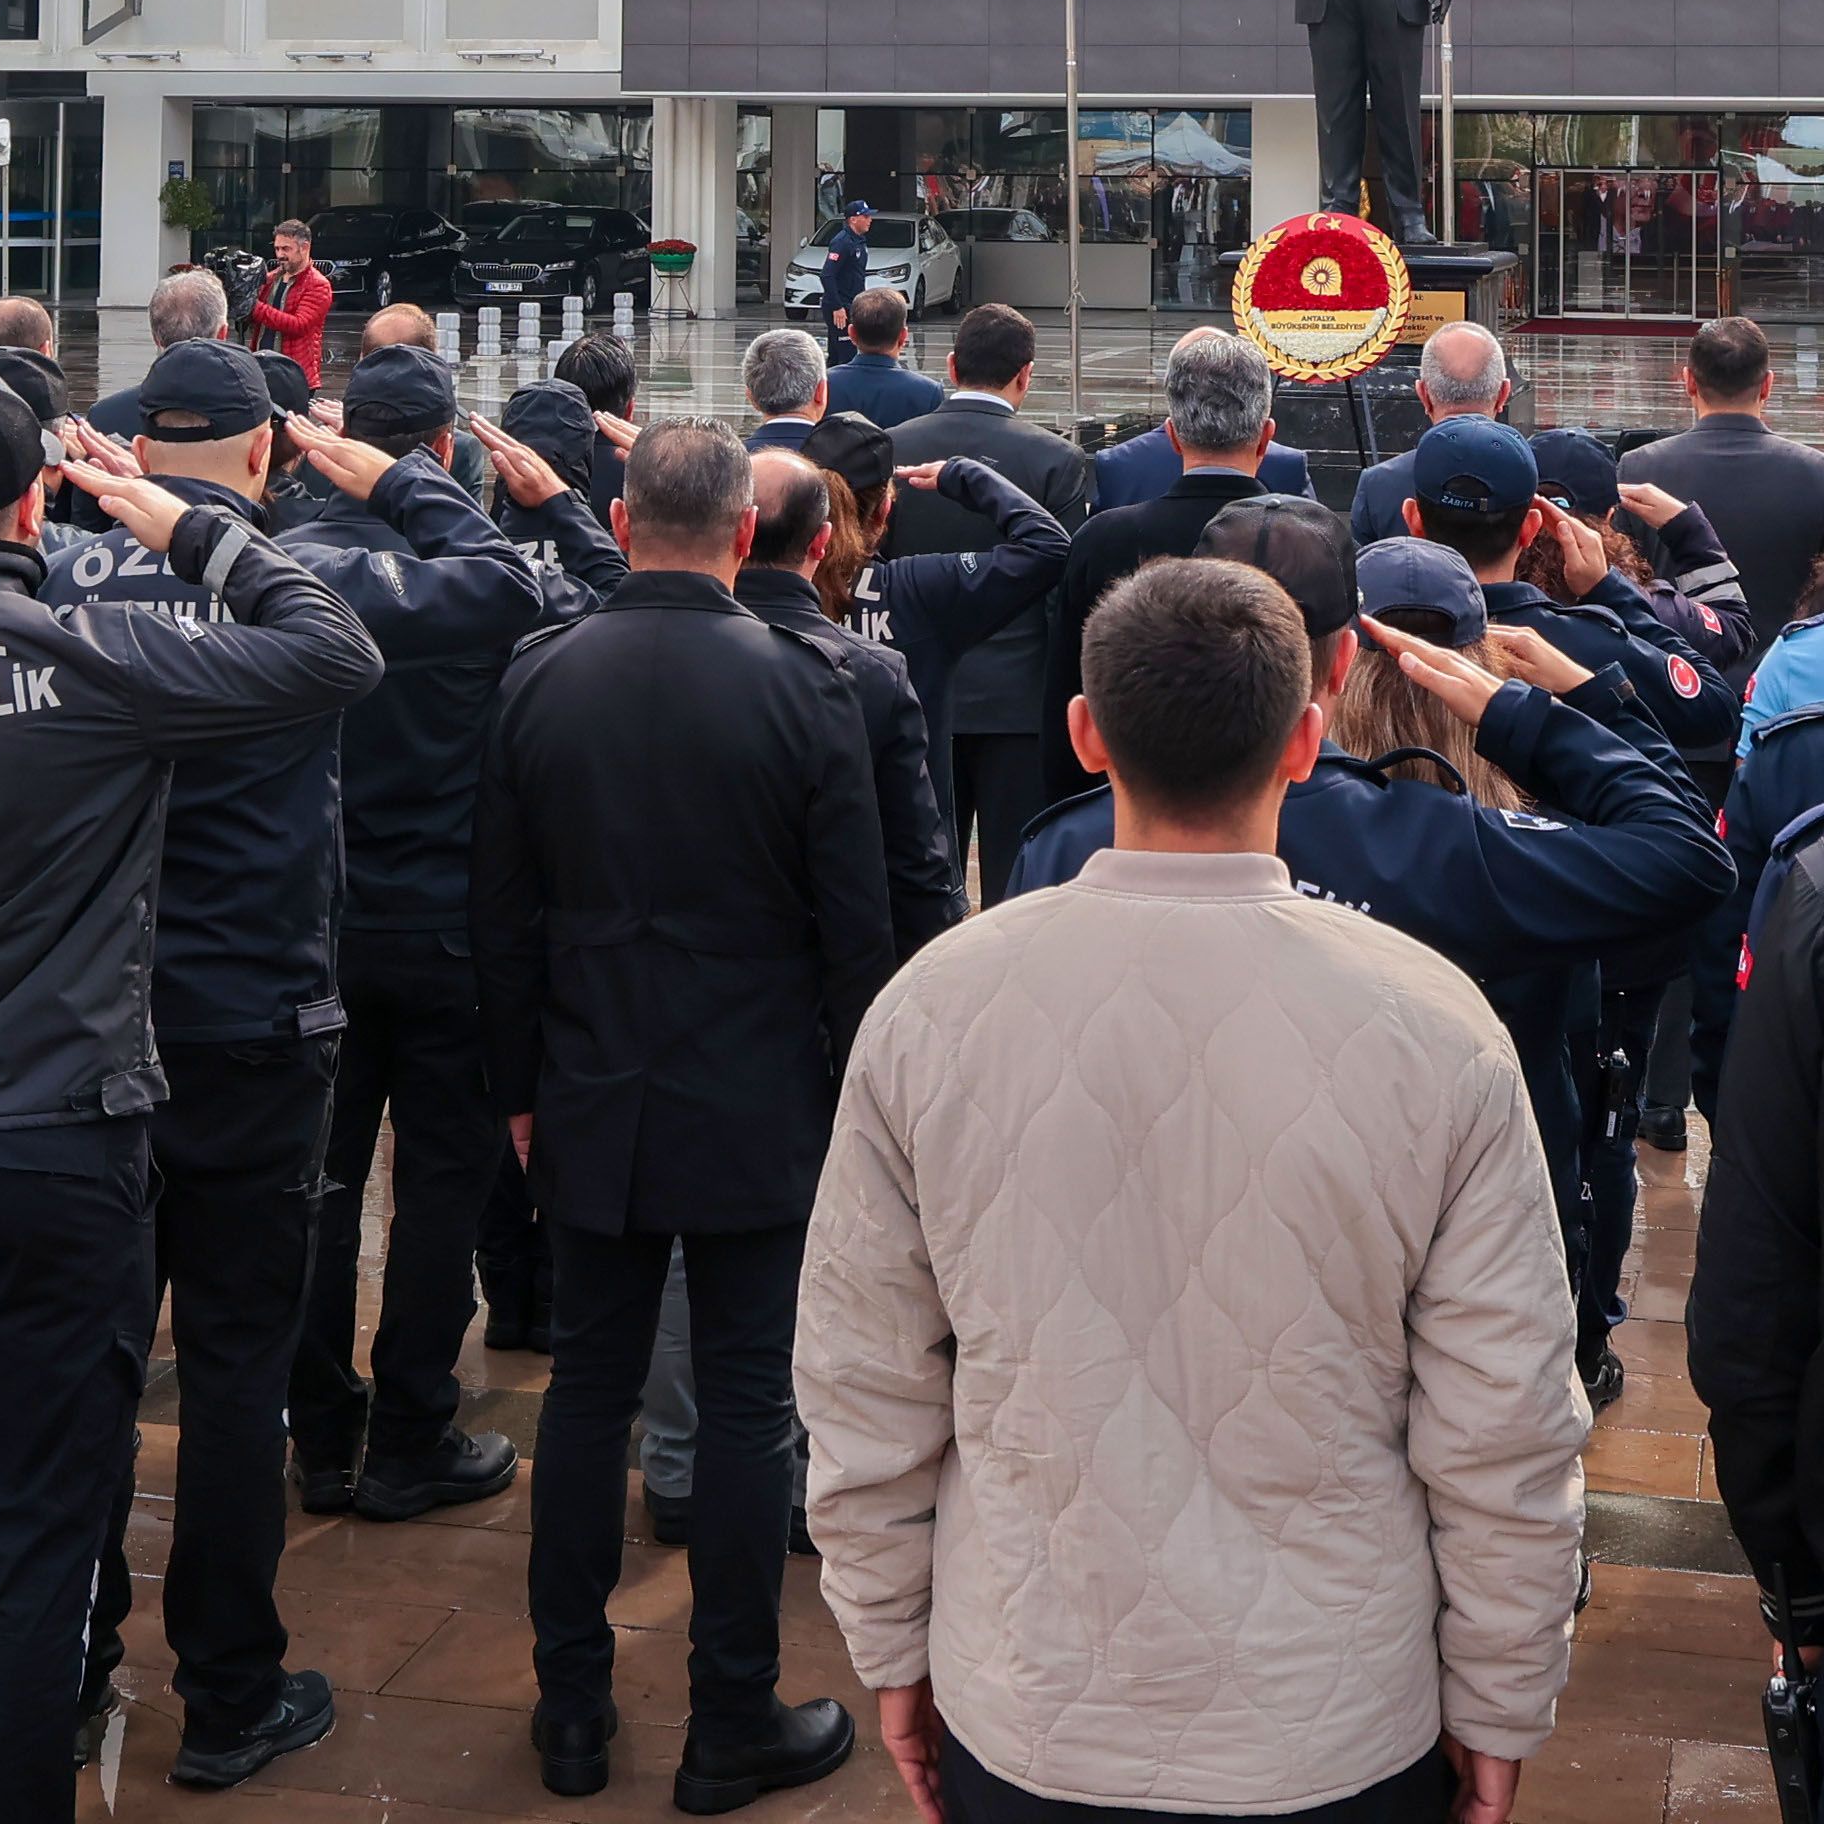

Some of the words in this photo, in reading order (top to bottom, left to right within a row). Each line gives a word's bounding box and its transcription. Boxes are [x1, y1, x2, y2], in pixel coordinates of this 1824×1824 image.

[1271, 321, 1320, 330] BÜYÜKŞEHİR
[1321, 321, 1367, 330] BELEDİYESİ
[1441, 495, 1475, 509] ZABITA
